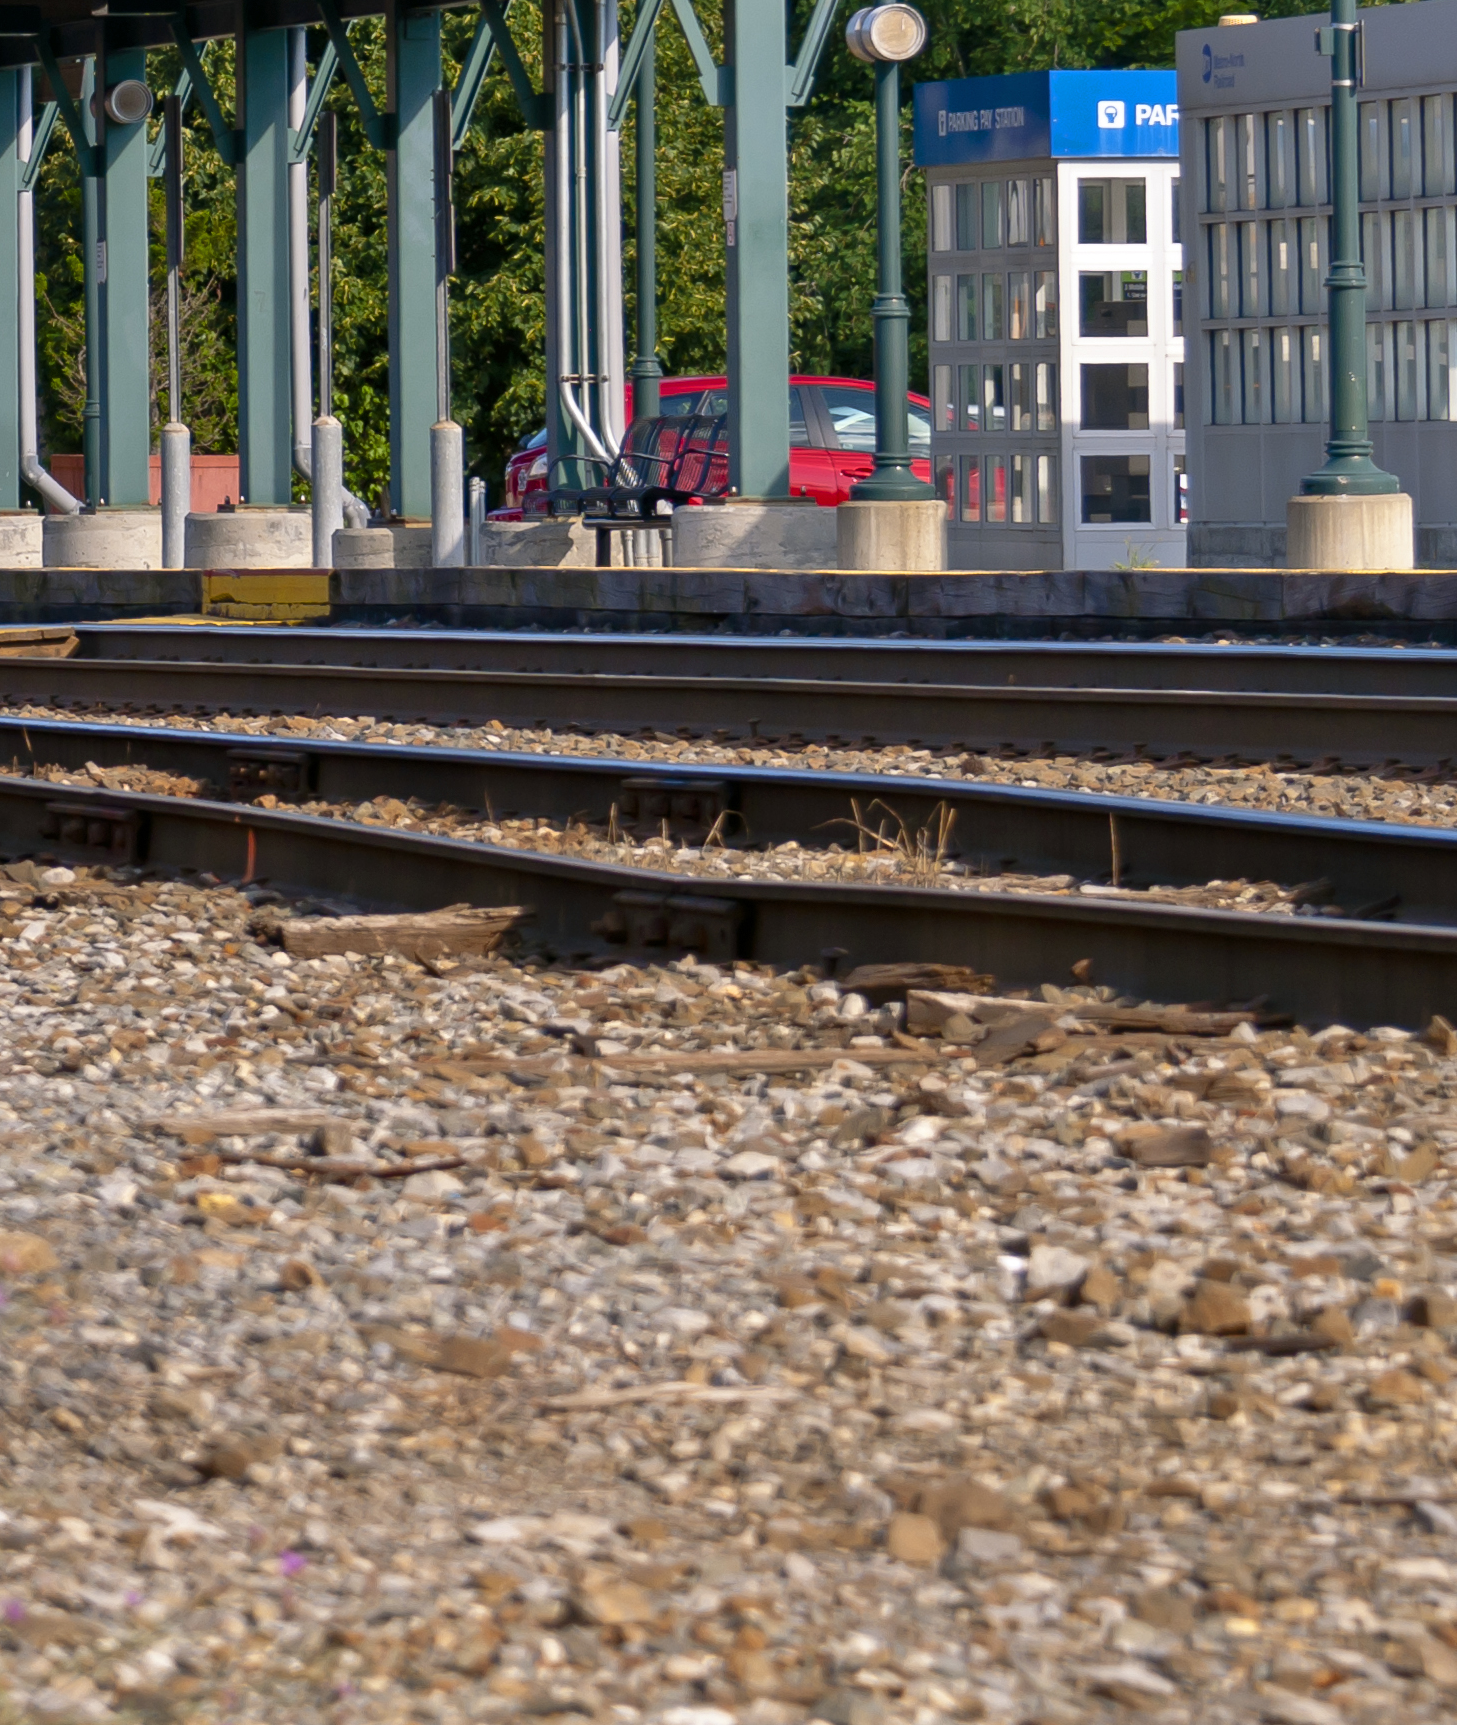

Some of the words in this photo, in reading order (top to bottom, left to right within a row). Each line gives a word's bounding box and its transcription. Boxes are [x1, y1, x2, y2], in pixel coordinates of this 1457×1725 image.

[948, 110, 979, 132] PARKING
[980, 109, 993, 130] PAY
[994, 107, 1024, 129] STATION
